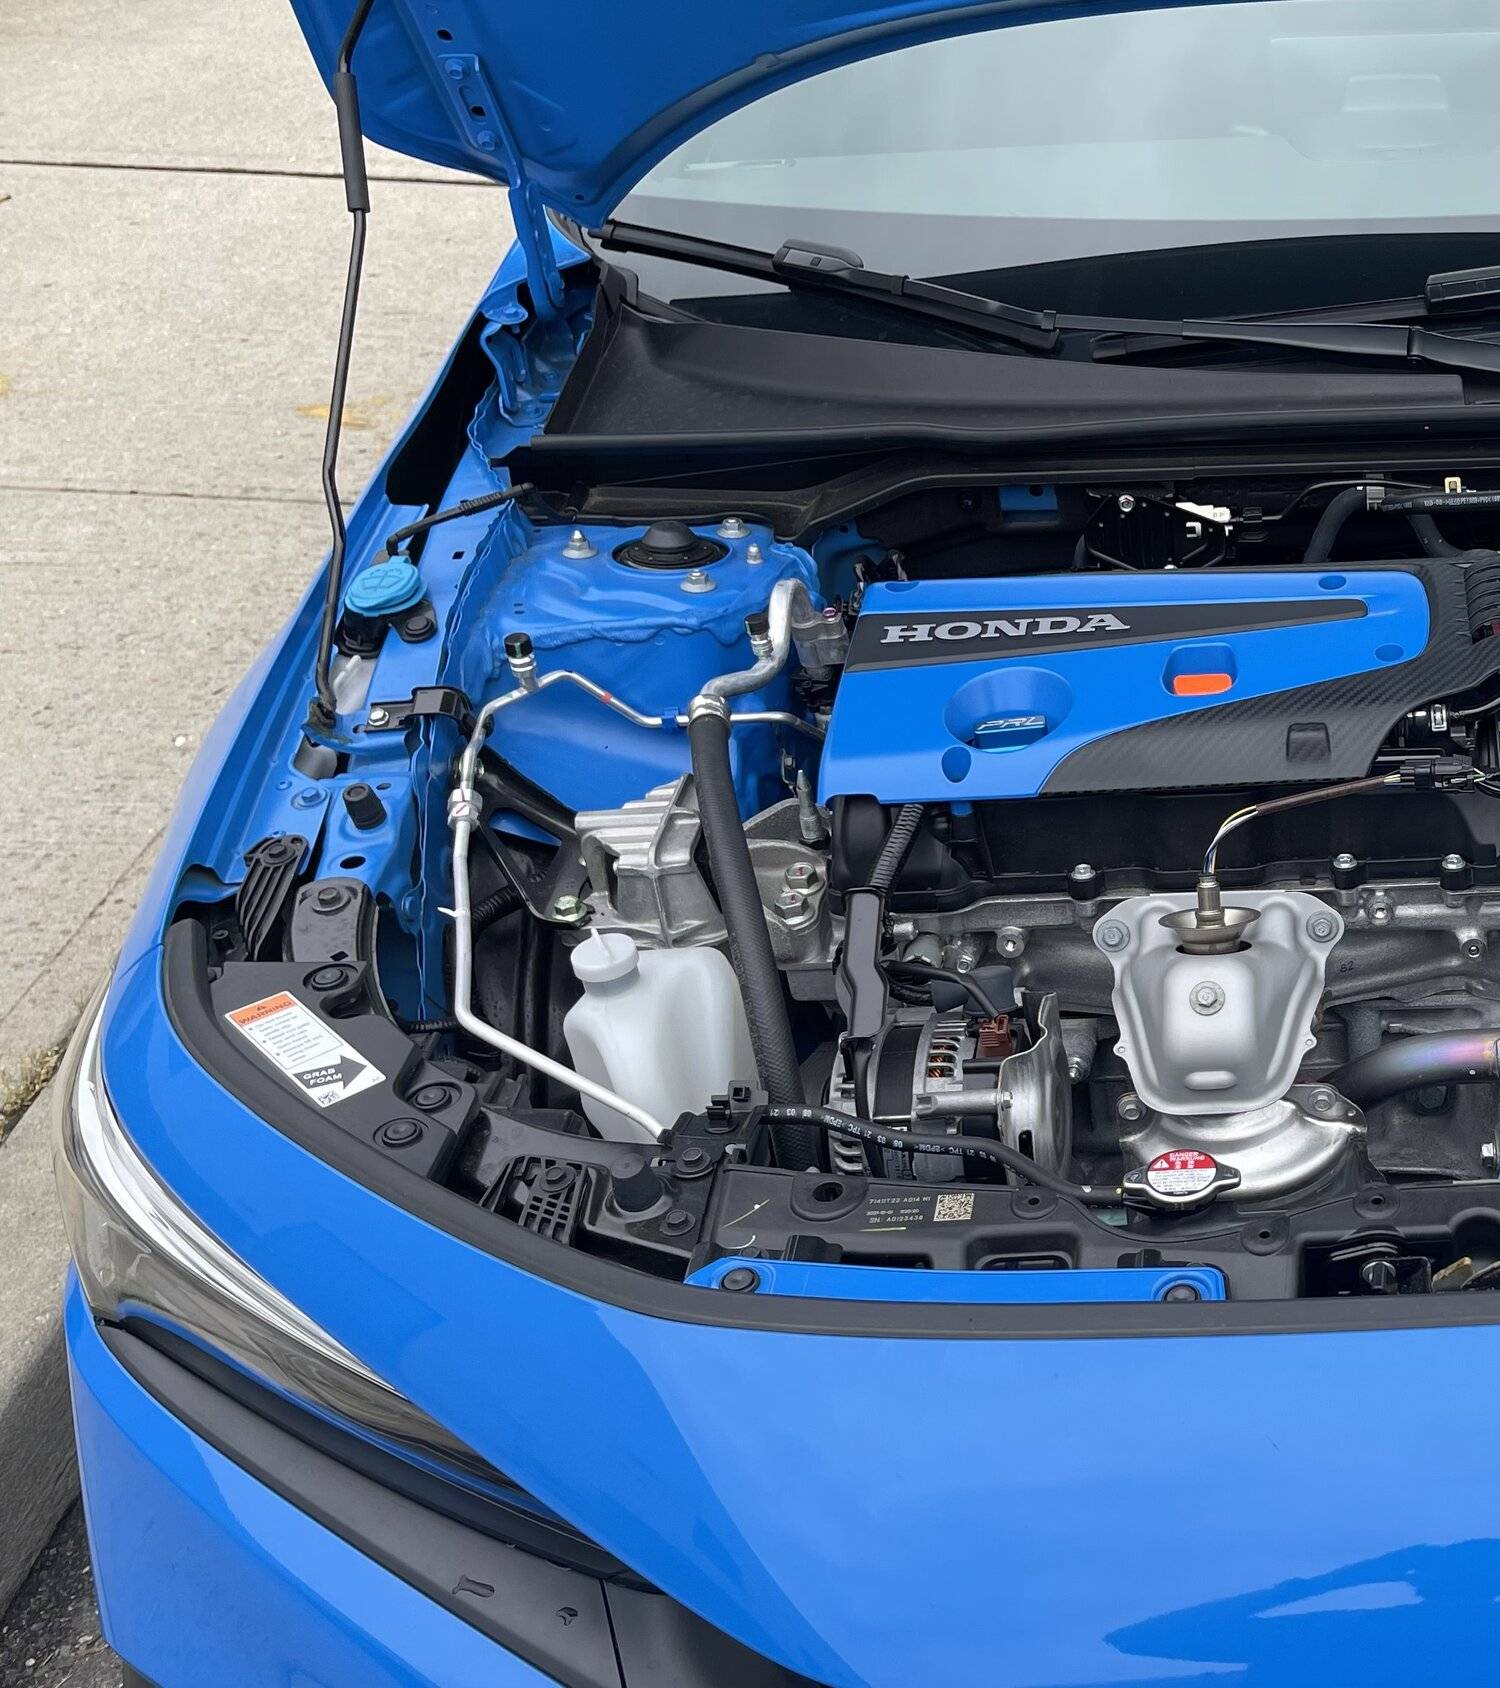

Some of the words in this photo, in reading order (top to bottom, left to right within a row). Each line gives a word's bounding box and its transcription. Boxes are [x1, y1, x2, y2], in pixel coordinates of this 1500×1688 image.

[880, 613, 1131, 644] HONDA
[976, 716, 1044, 730] PRL
[238, 1000, 294, 1025] WARNING
[302, 1068, 337, 1081] GRAB
[309, 1073, 344, 1086] FOAM
